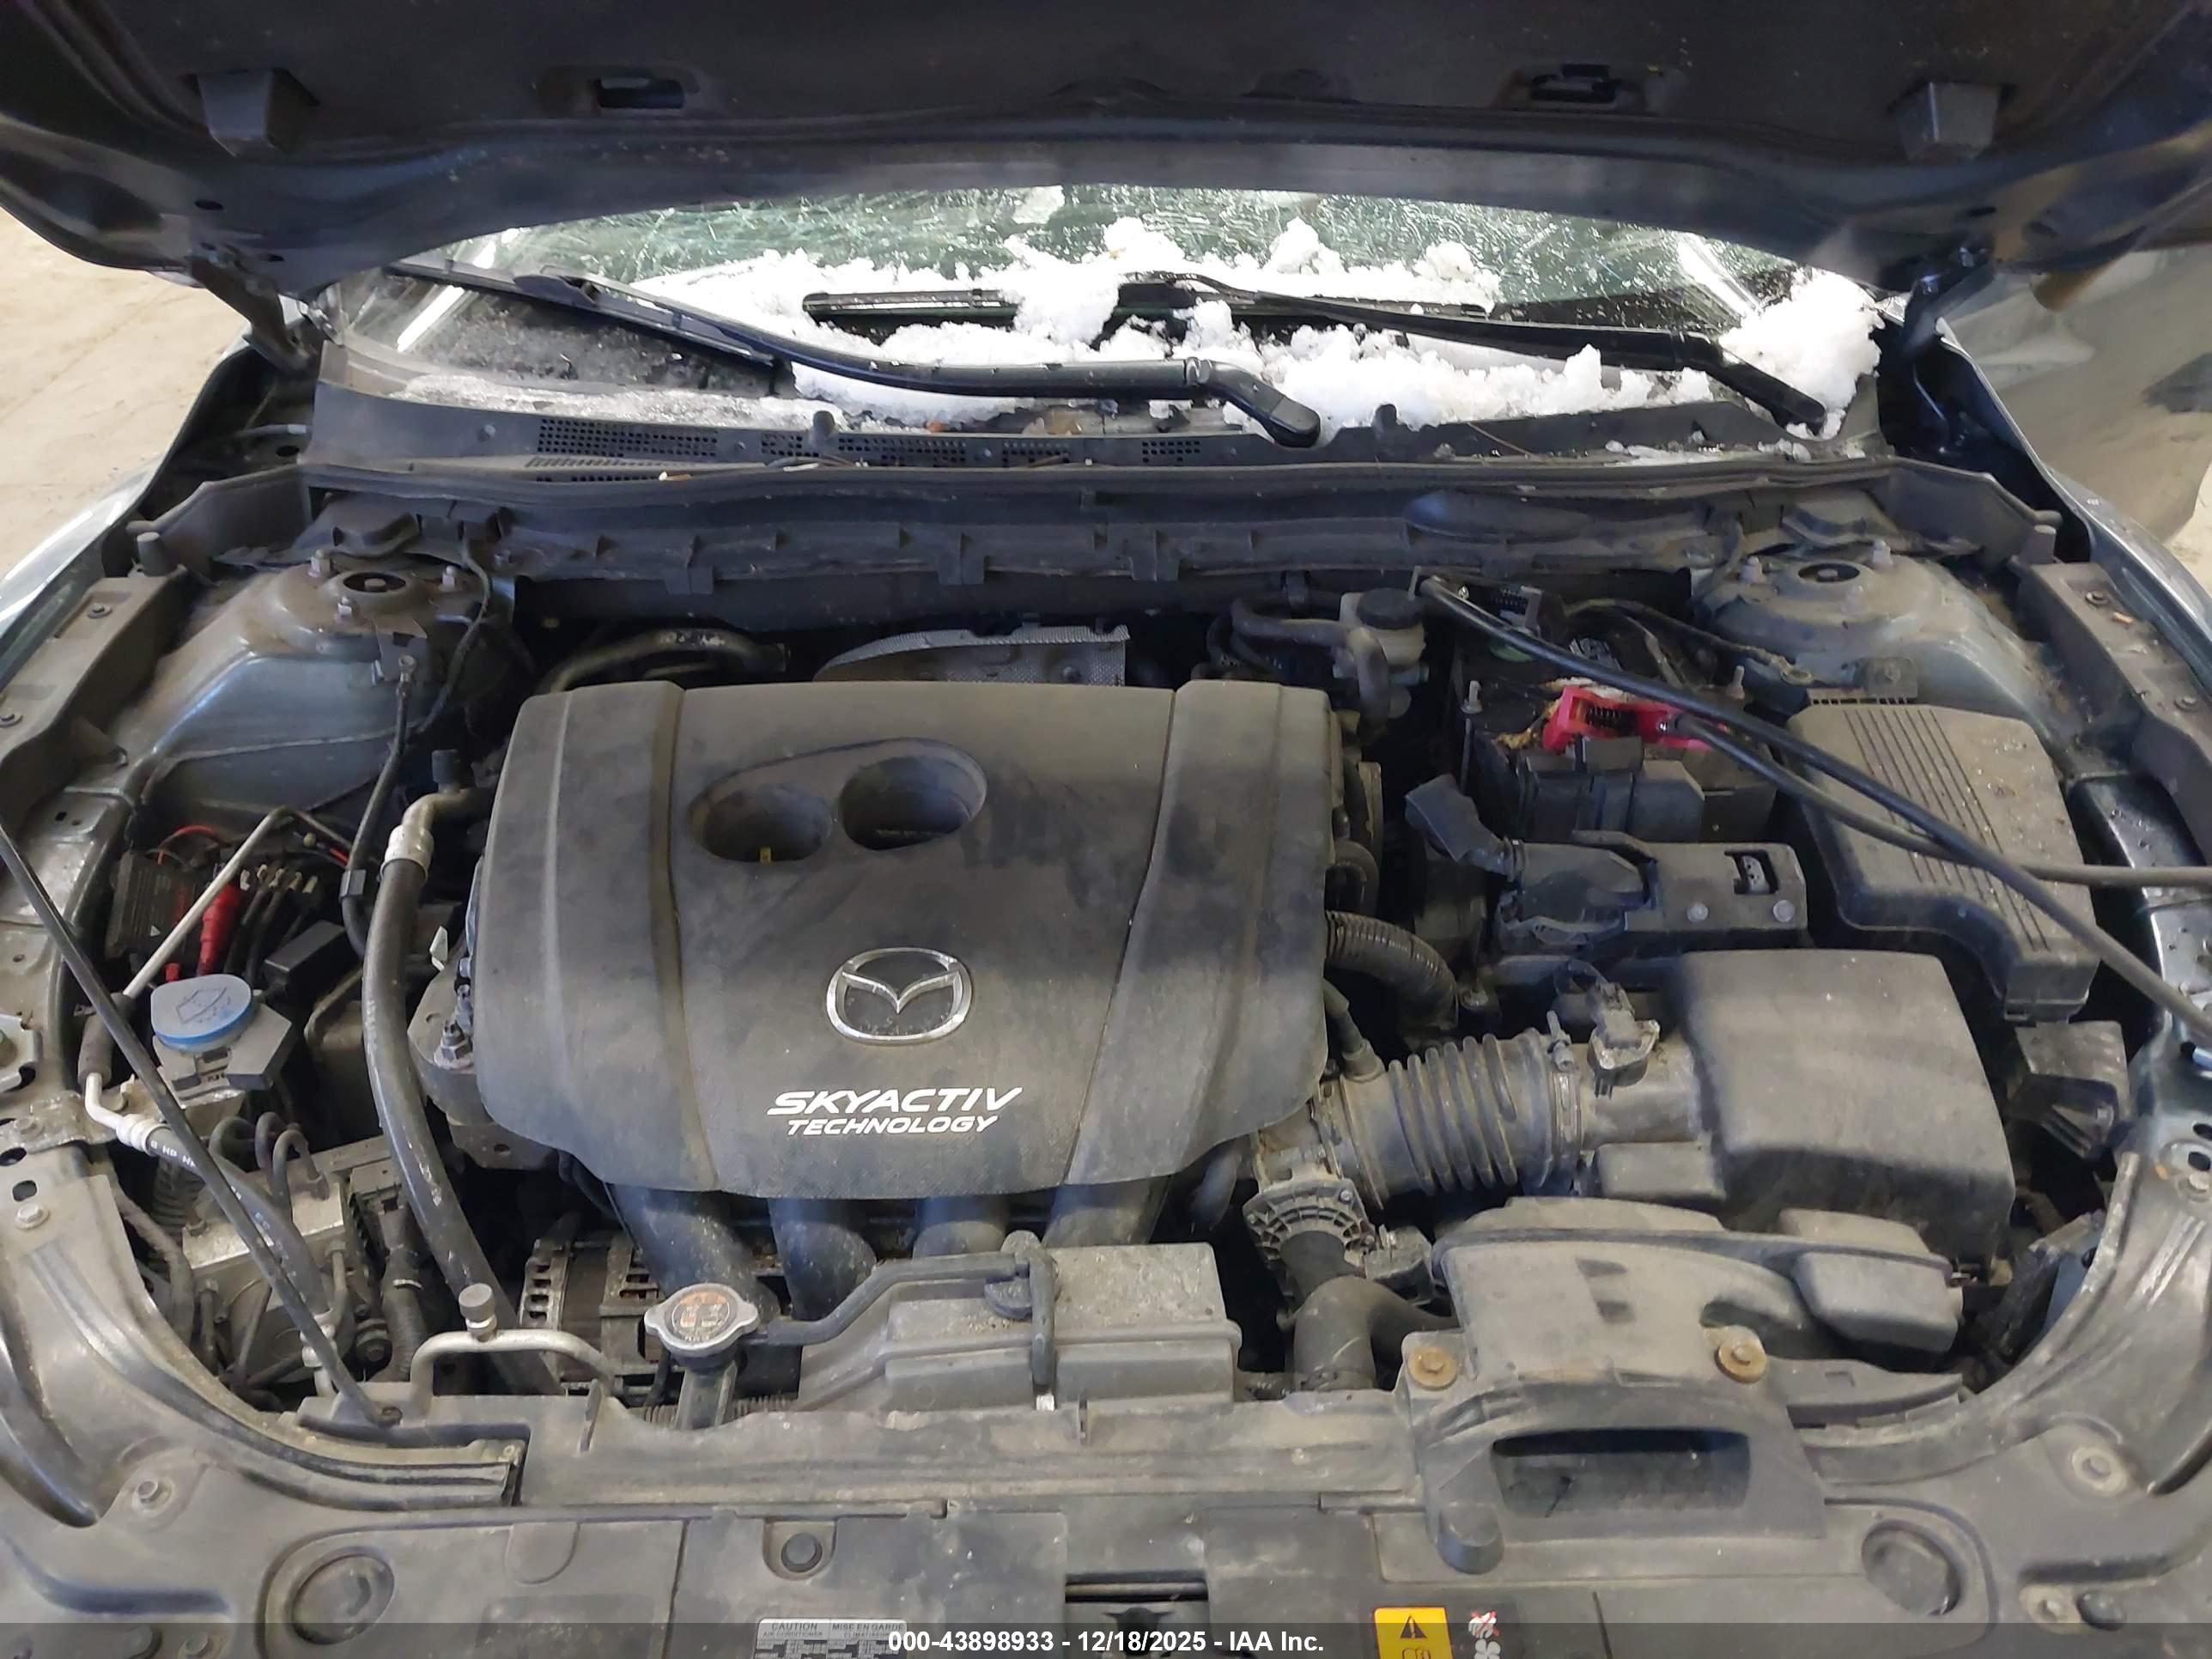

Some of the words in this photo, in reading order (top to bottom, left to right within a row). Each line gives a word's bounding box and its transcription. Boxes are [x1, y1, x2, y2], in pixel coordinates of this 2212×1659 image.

[767, 1087, 1023, 1115] SKYACTIV
[787, 1115, 999, 1136] TECHNOLOGY
[771, 1622, 817, 1631] CAUTION
[871, 1623, 904, 1632] GARDE
